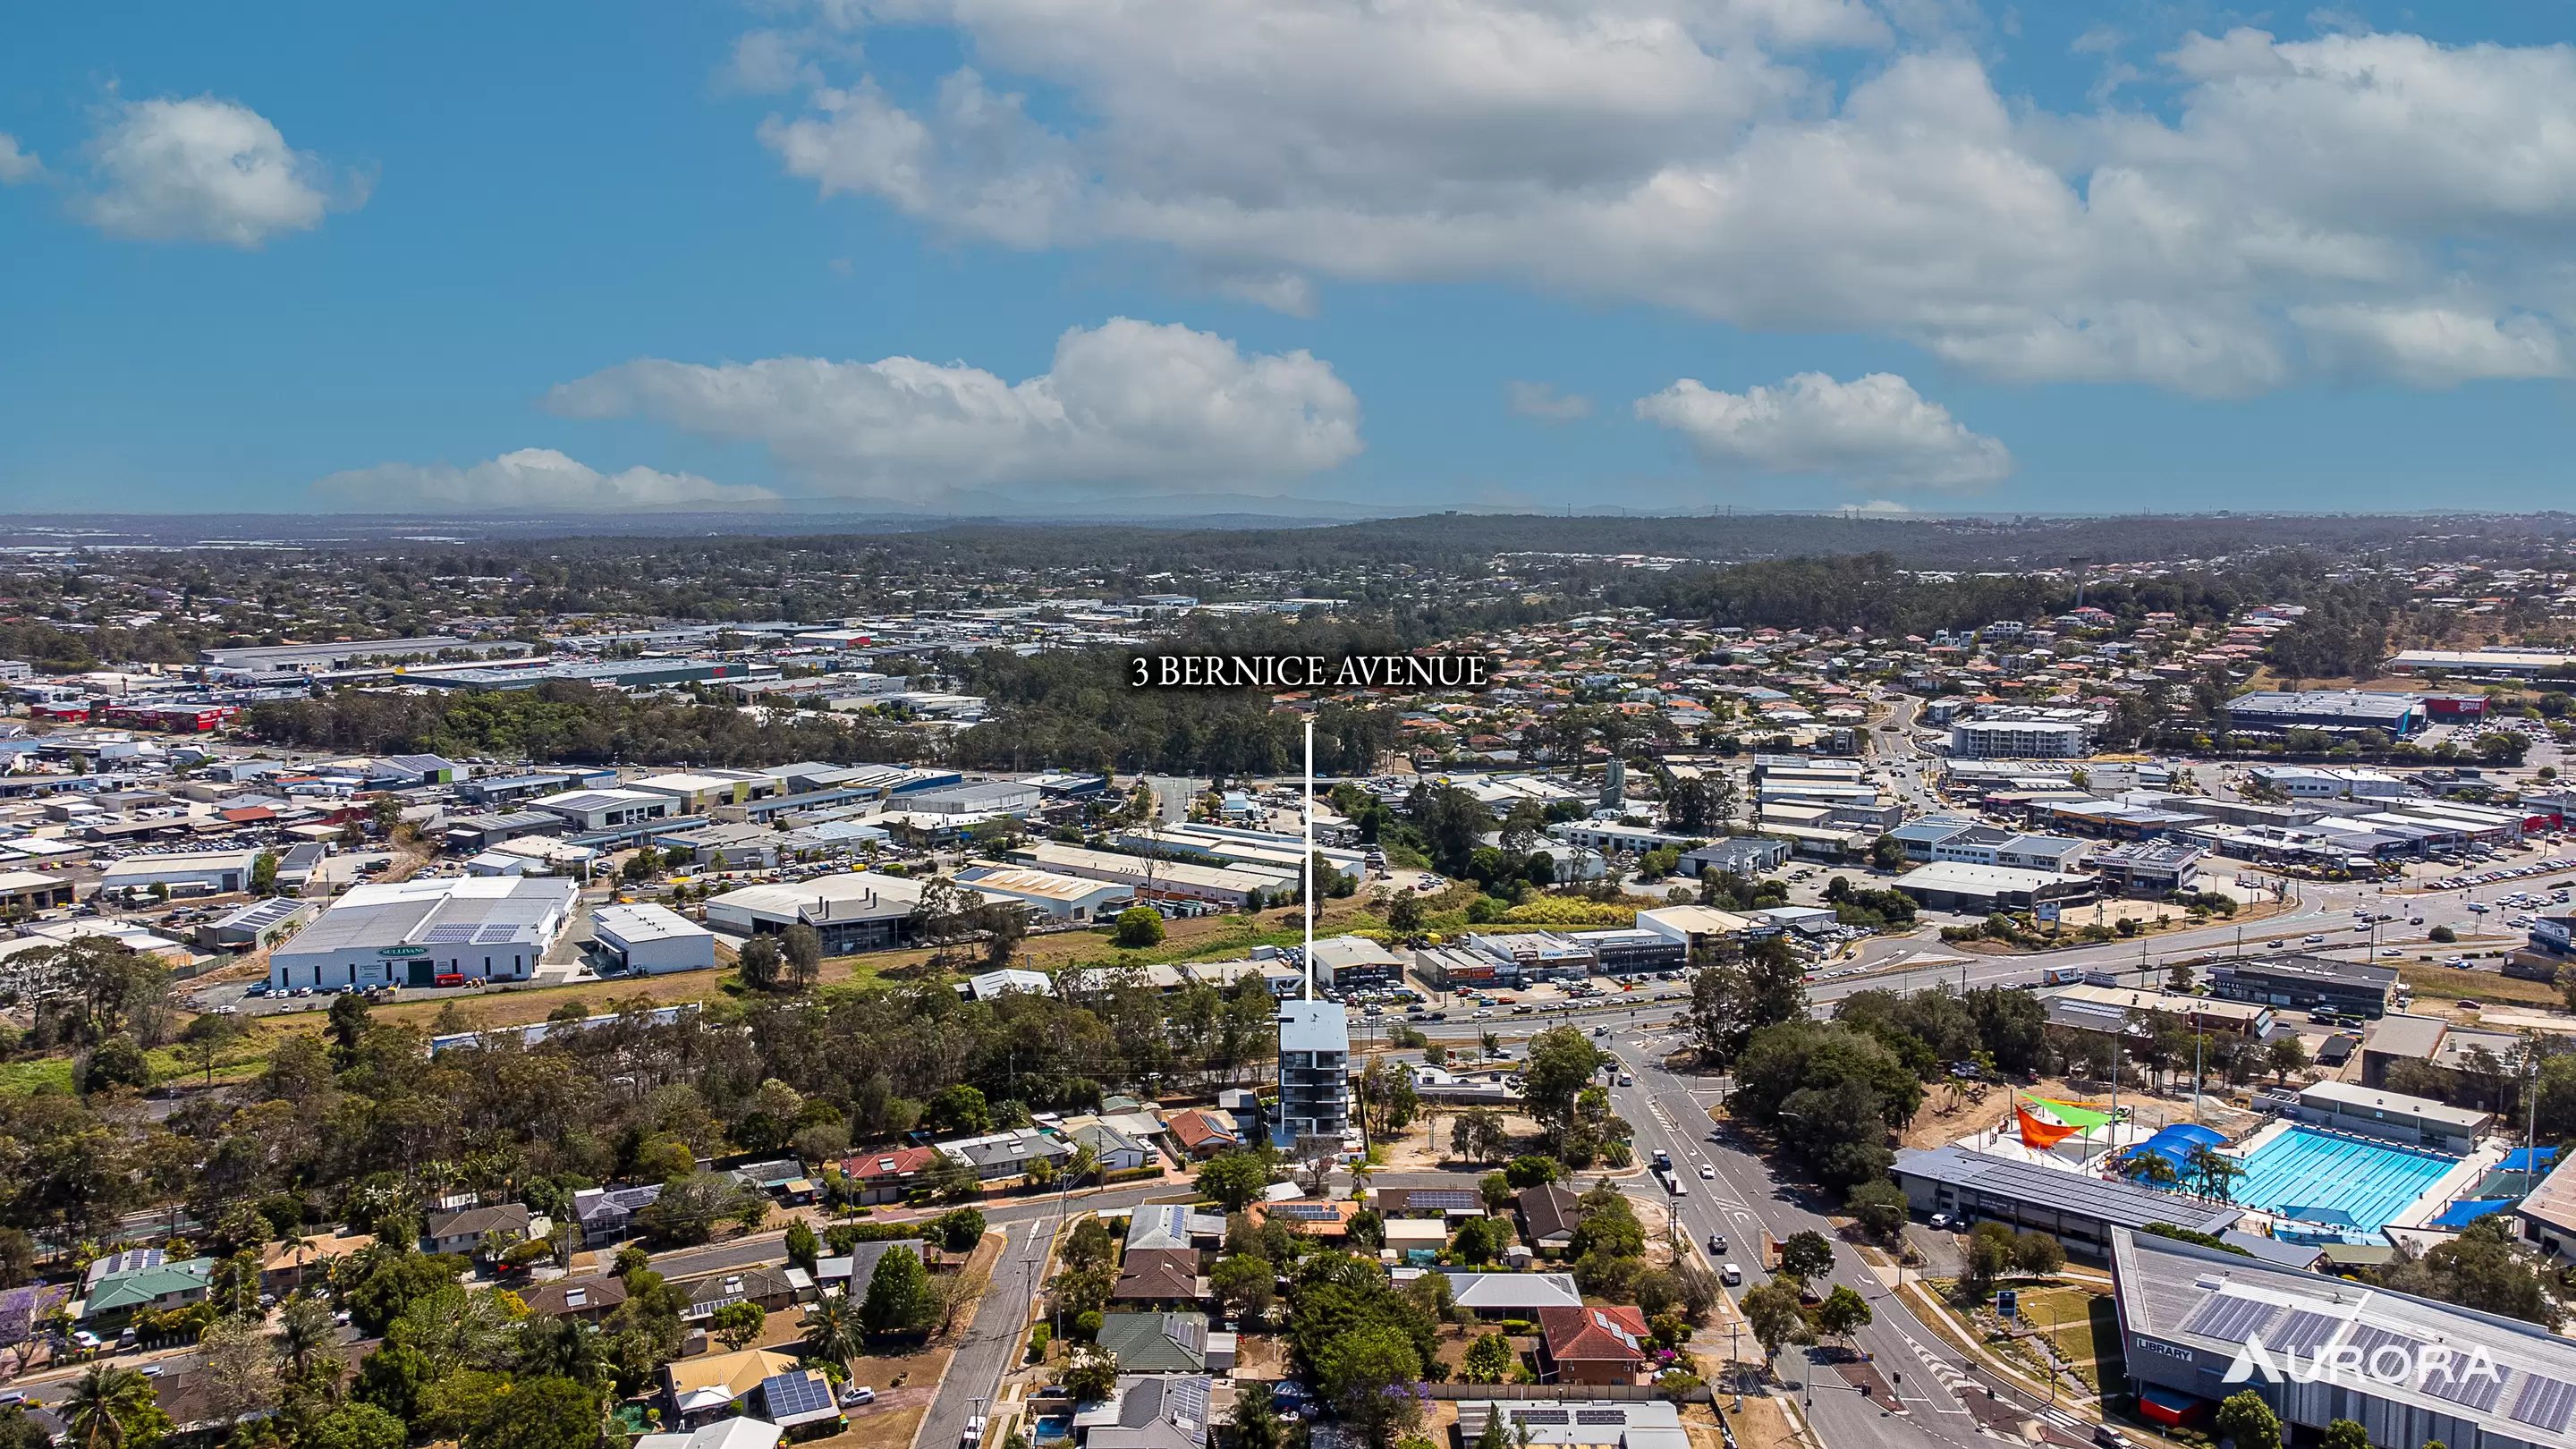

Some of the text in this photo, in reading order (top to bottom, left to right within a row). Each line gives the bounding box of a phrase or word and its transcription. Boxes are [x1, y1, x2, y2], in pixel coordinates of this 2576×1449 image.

[2096, 857, 2130, 865] HONDA
[382, 947, 426, 955] SULLIVANS
[2138, 1339, 2190, 1360] LIBRARY
